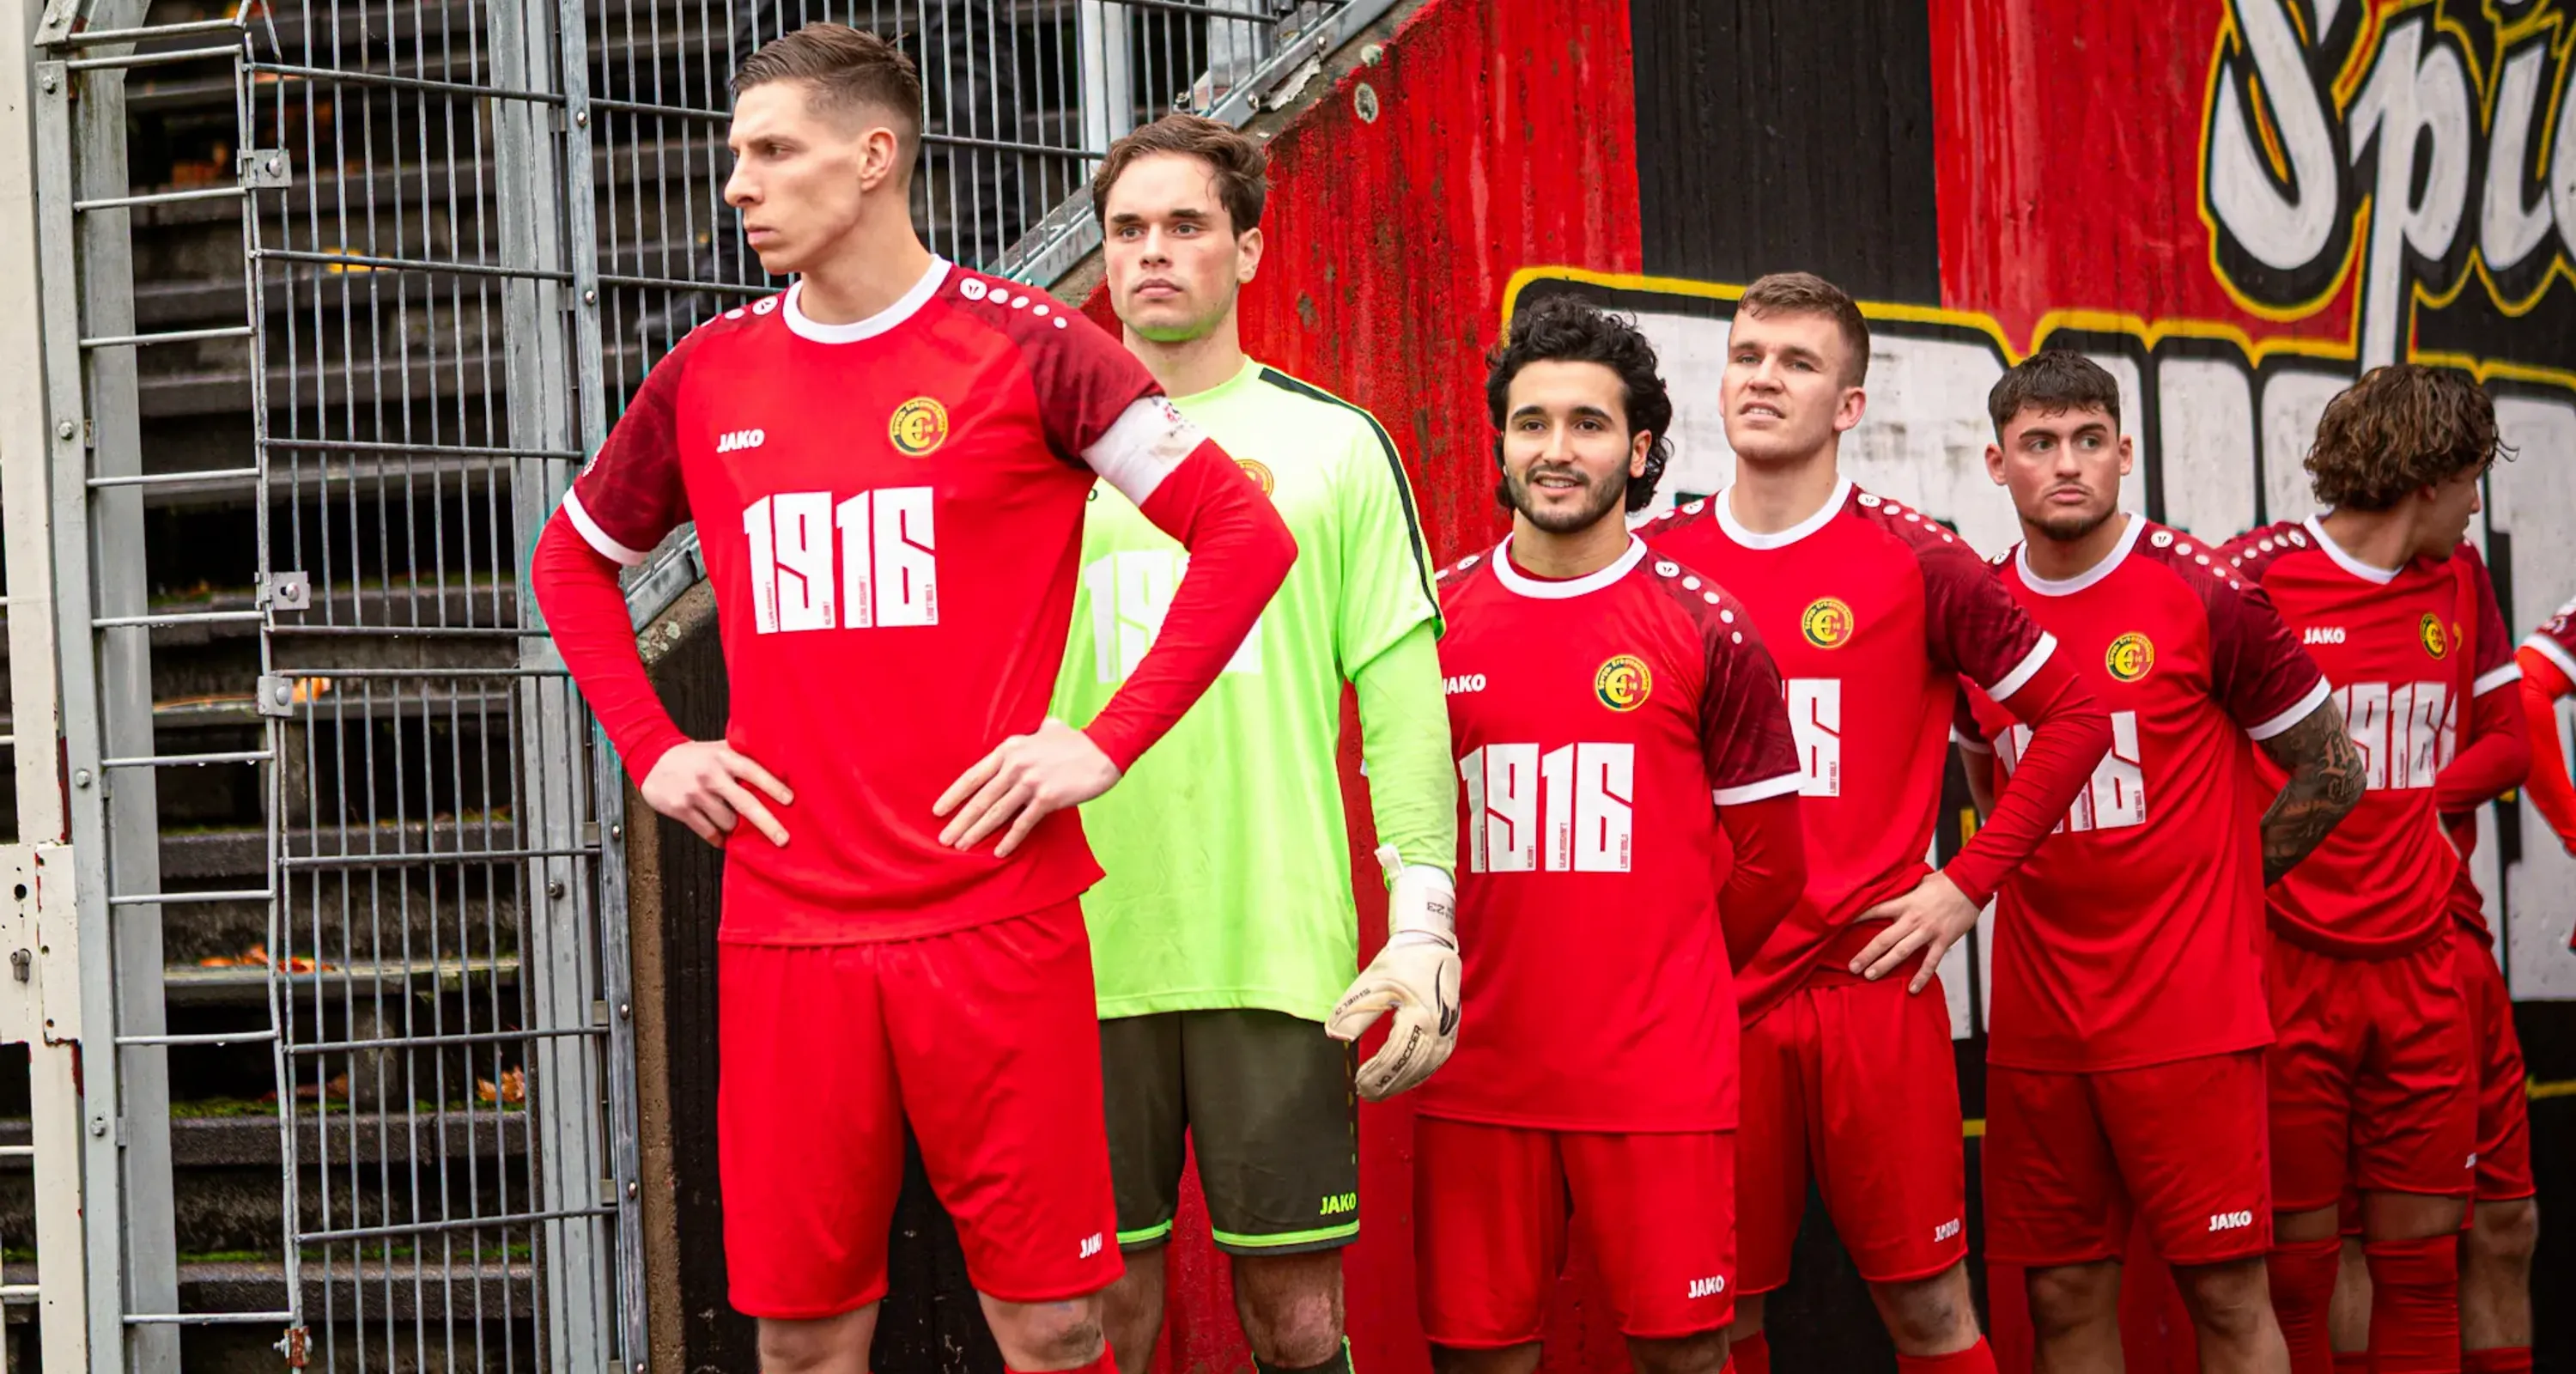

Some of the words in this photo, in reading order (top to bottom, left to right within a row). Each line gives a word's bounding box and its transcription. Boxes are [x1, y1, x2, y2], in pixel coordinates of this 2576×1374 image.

[2209, 0, 2576, 369] Spi
[716, 429, 765, 453] JAKO
[742, 486, 939, 635] 1916
[2302, 626, 2346, 644] JAKO
[1458, 742, 1635, 874] 1916
[1391, 1024, 1423, 1073] SOCCER
[1319, 1192, 1357, 1216] JAKO
[2208, 1210, 2252, 1231] JAKO
[1688, 1275, 1725, 1298] JAKO
